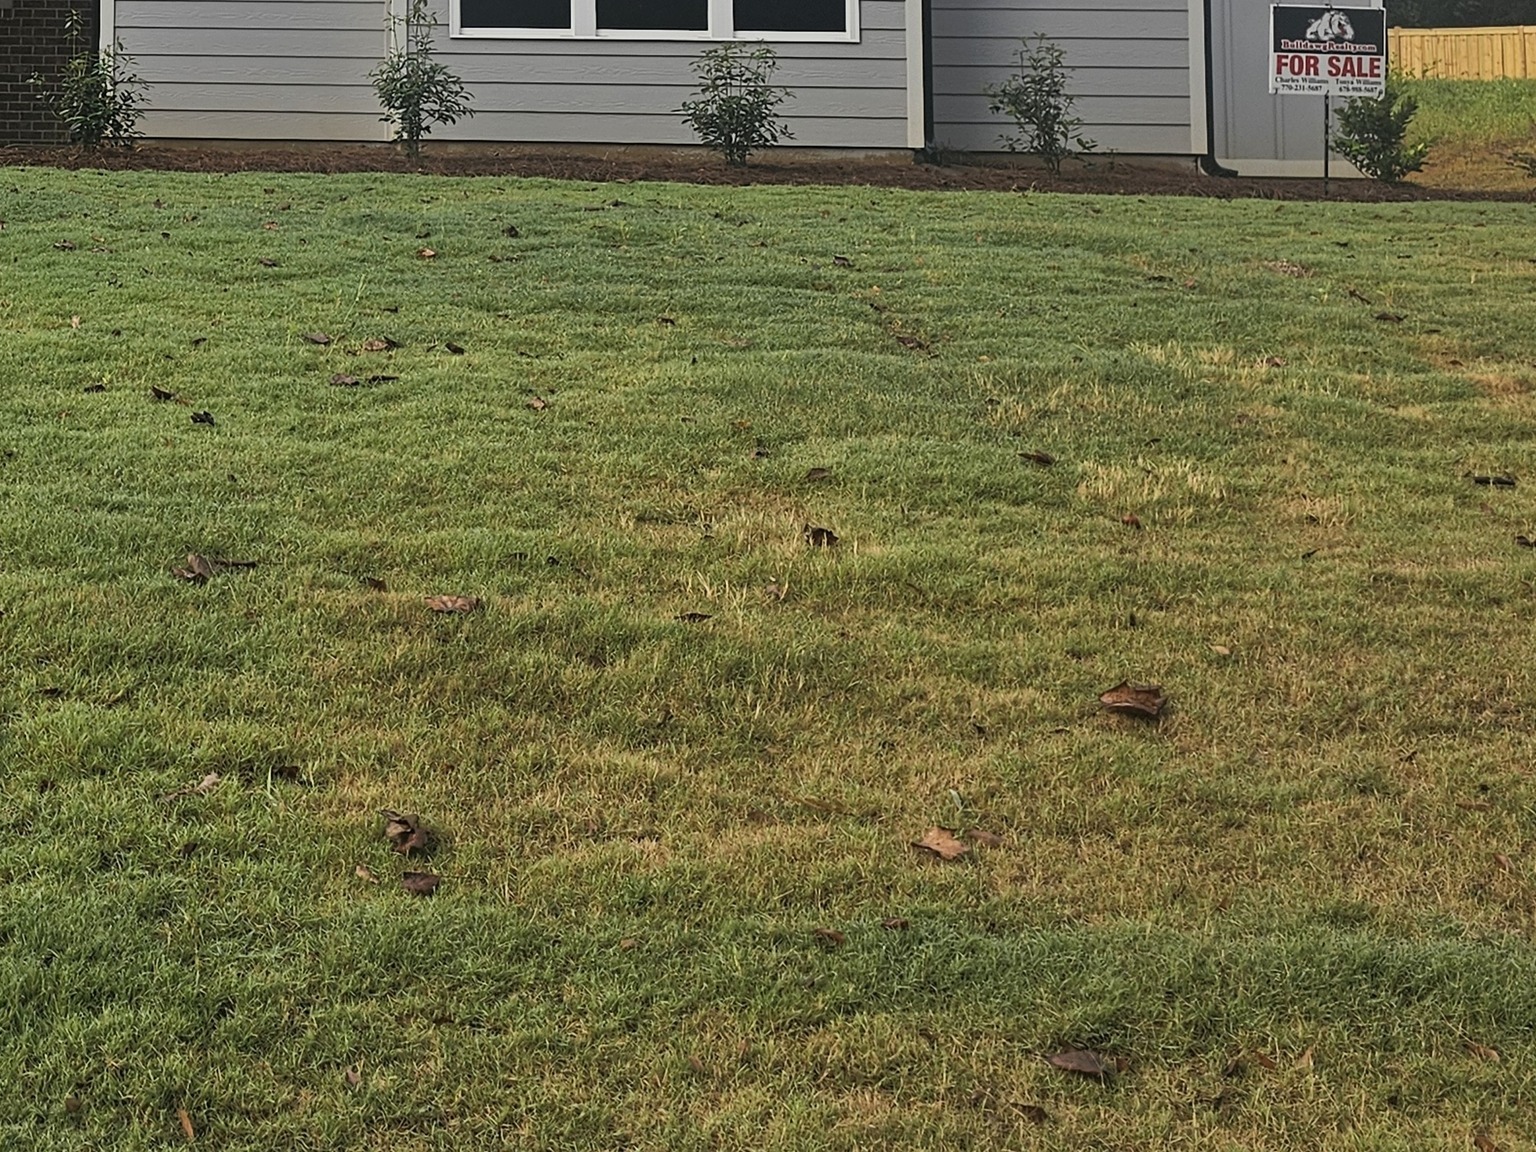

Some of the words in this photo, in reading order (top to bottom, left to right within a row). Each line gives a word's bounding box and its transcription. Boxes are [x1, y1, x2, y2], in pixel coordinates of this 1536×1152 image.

[1281, 39, 1377, 52] BulldawgRealty.com
[1276, 54, 1319, 76] FOR
[1327, 56, 1381, 77] SALE
[1335, 78, 1354, 86] Tonya
